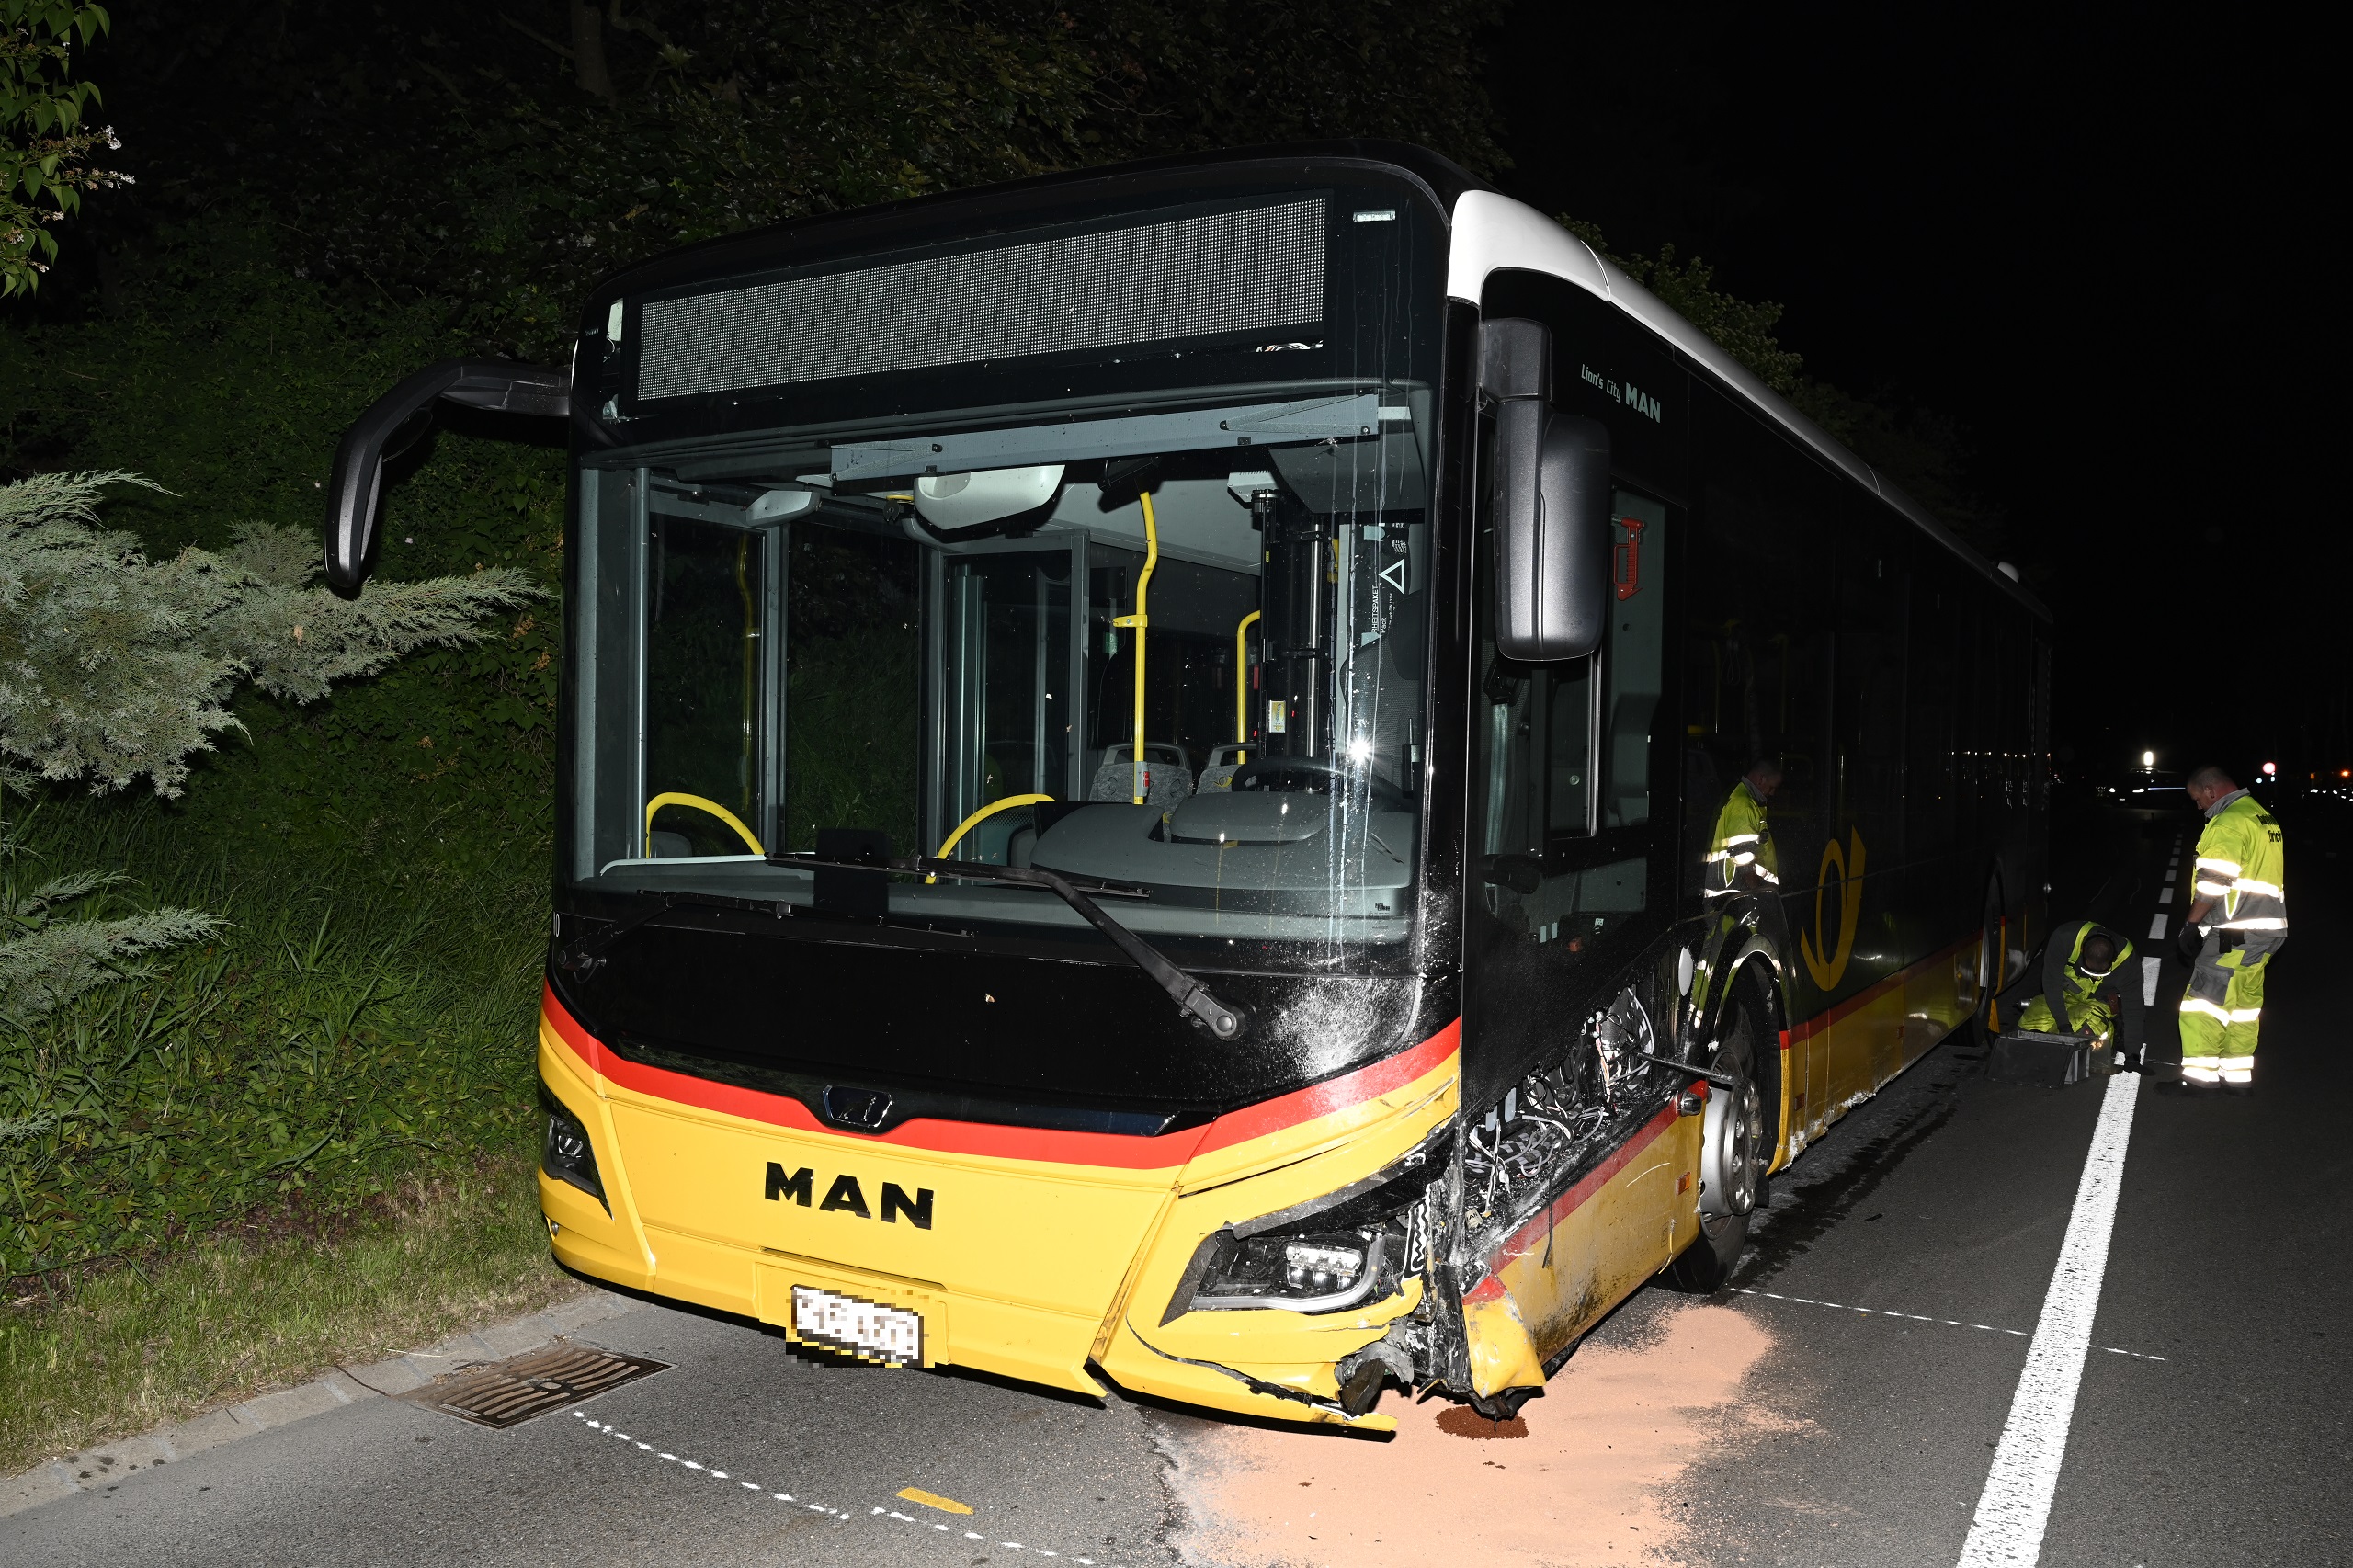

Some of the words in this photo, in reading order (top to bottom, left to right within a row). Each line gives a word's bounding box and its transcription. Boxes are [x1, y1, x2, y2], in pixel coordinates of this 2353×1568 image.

[1580, 363, 1604, 390] Lion's
[1606, 379, 1621, 403] City
[1625, 381, 1661, 424] MAN
[765, 1161, 934, 1231] MAN
